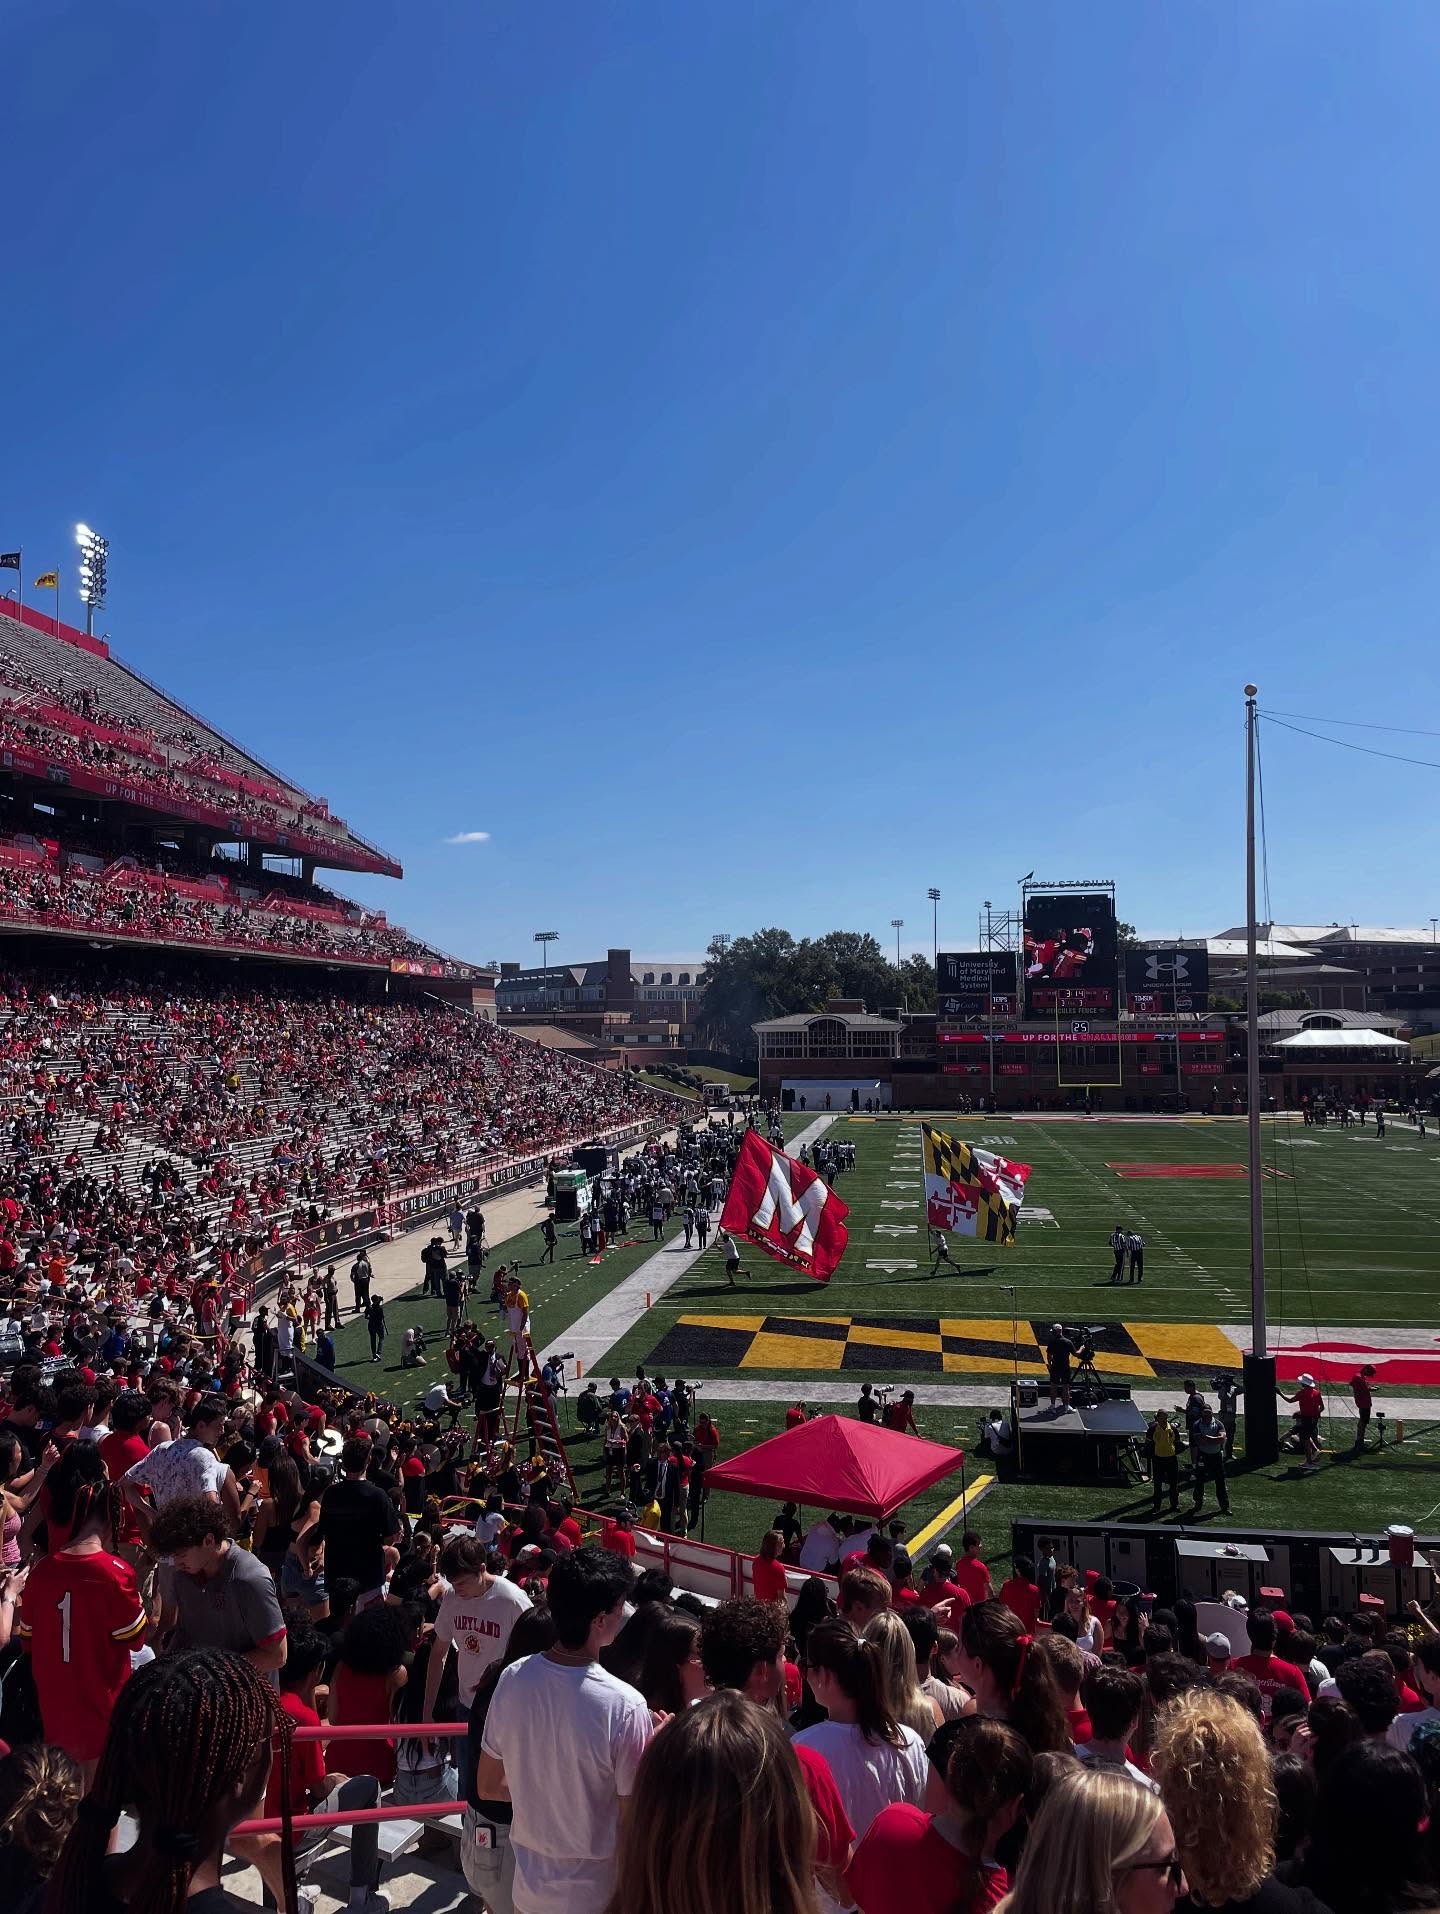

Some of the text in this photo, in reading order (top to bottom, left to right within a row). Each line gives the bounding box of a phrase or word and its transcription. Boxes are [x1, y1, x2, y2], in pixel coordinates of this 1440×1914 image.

[105, 783, 117, 795] UP
[119, 787, 136, 801] FOR
[138, 792, 154, 806] THE
[1059, 880, 1115, 888] STADIUM
[960, 961, 999, 969] University
[960, 982, 988, 990] System
[1066, 990, 1084, 998] 3:14
[1074, 1022, 1087, 1032] 25
[57, 1591, 71, 1663] 1
